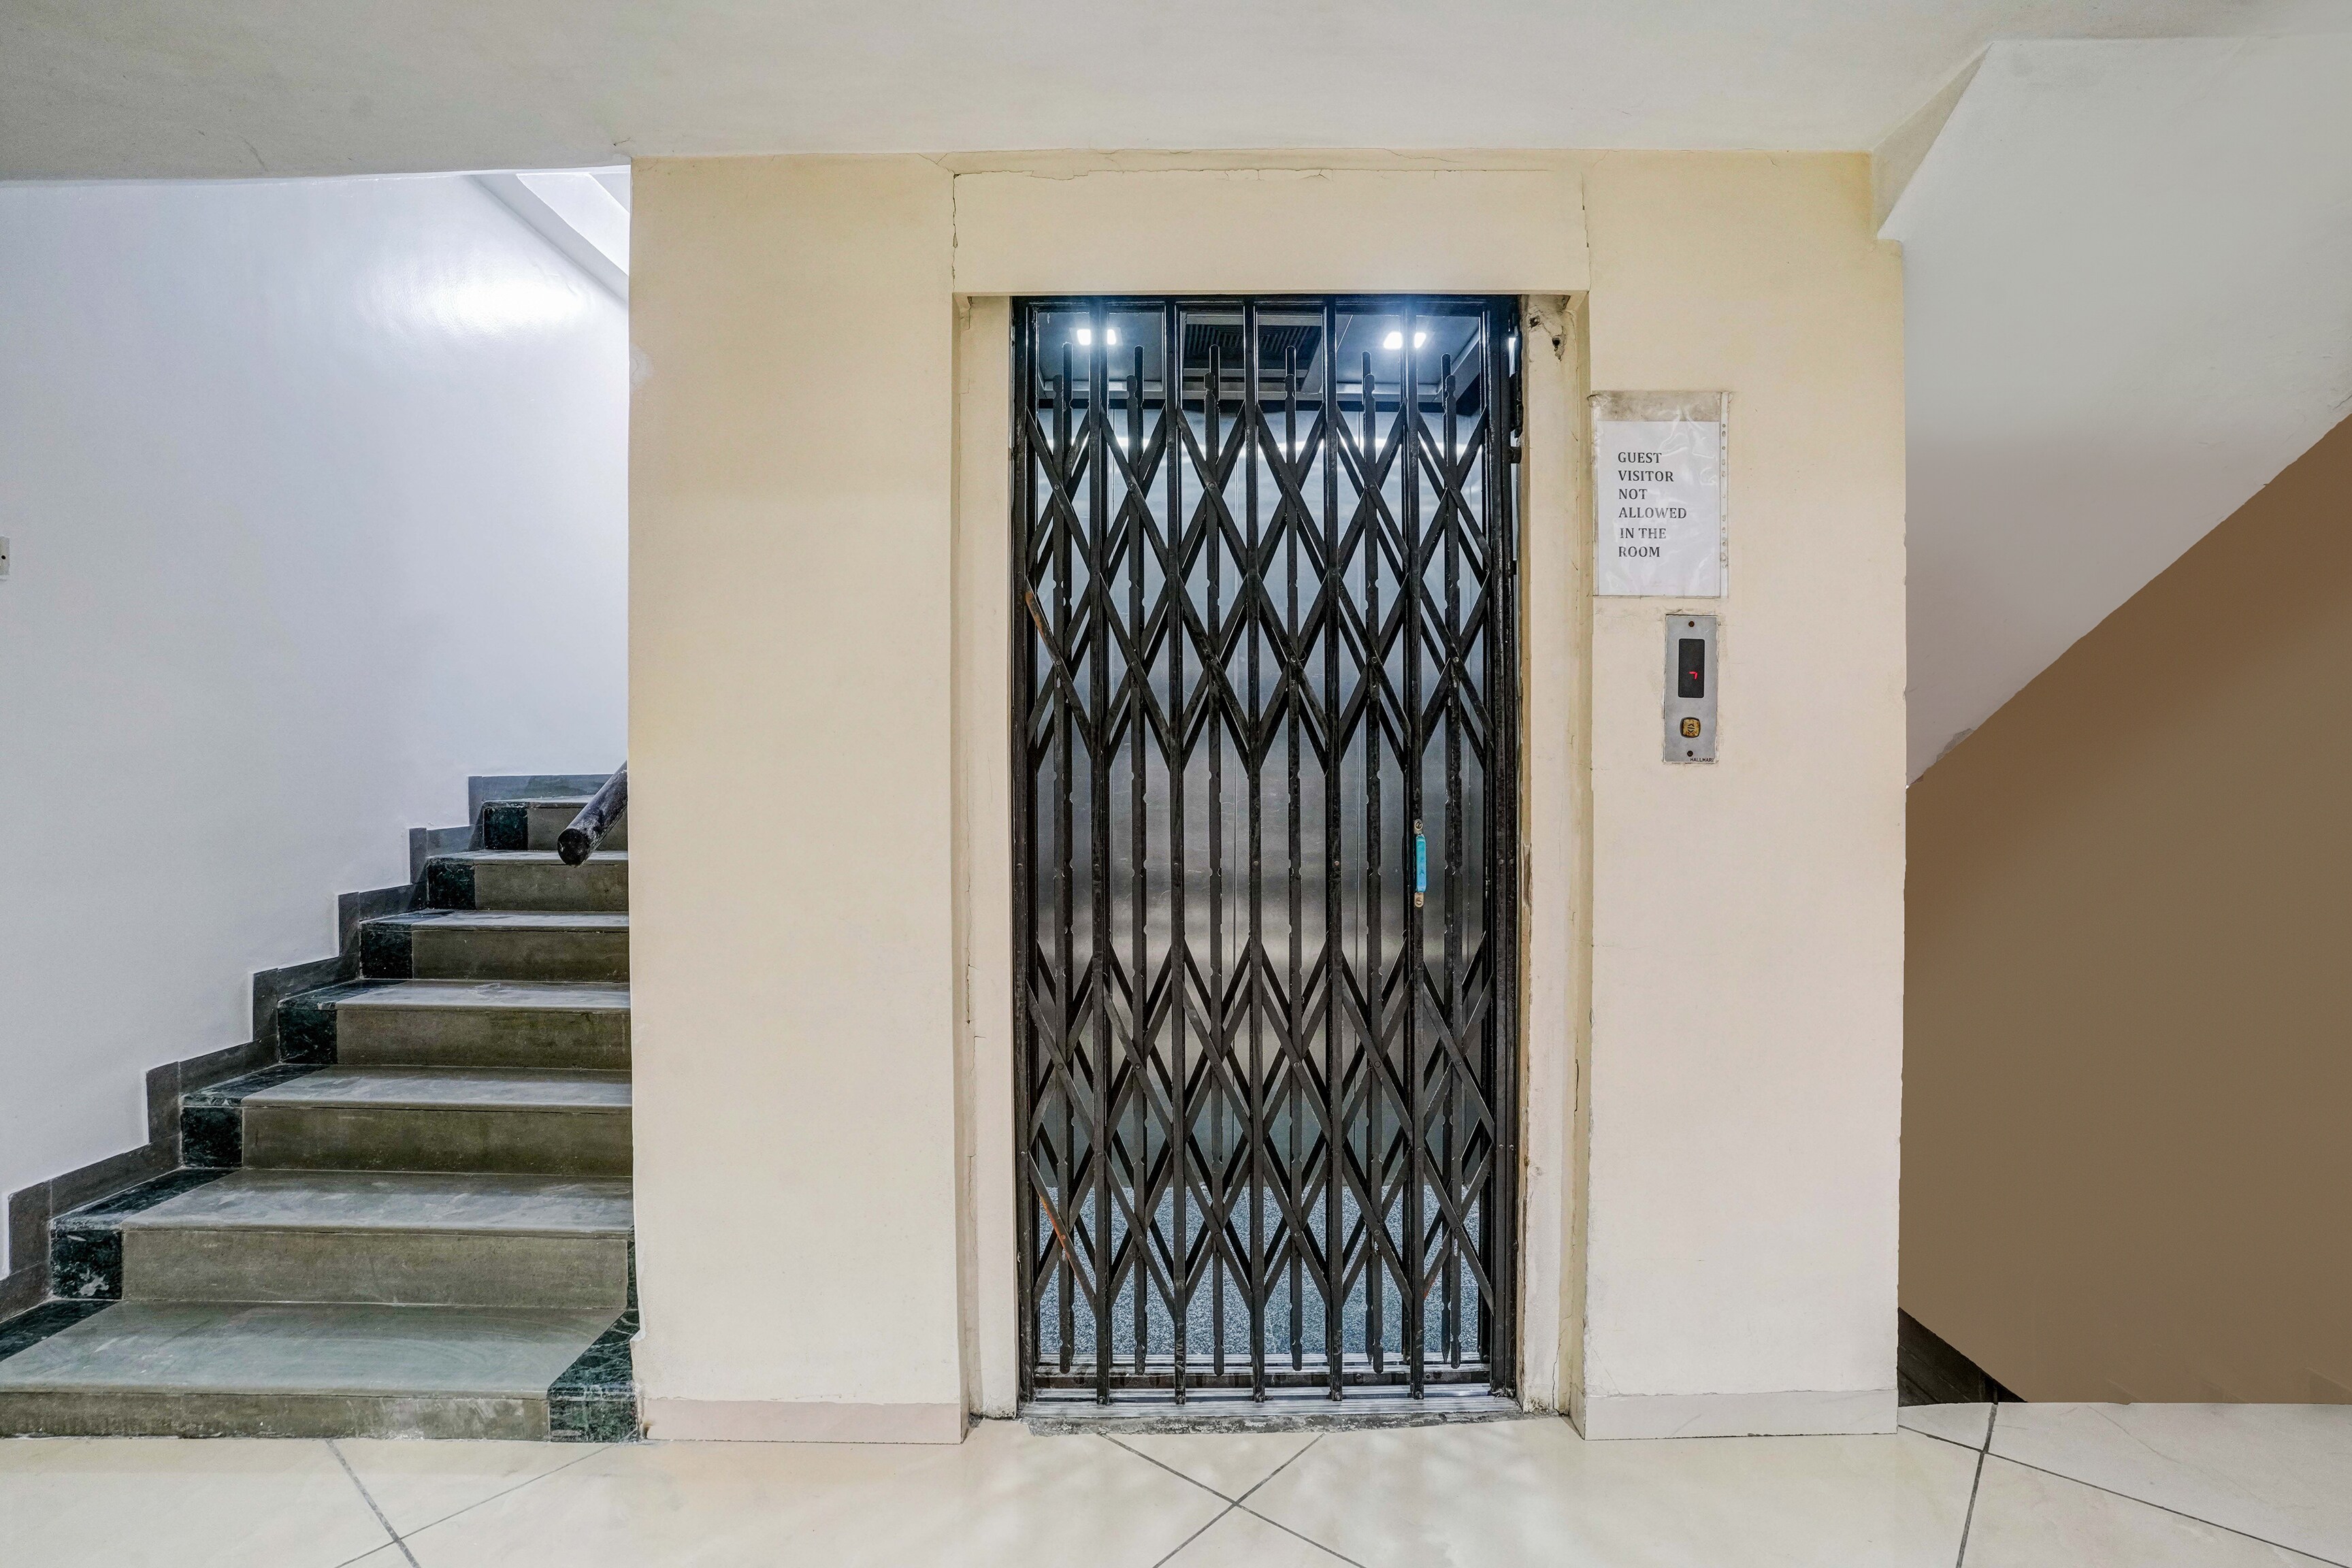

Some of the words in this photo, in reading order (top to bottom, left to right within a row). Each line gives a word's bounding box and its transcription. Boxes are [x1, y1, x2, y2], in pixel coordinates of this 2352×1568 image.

[1618, 452, 1662, 463] GUEST
[1618, 470, 1674, 482] VISITOR
[1618, 489, 1648, 500] NOT
[1618, 507, 1687, 519] ALLOWED
[1620, 527, 1634, 539] IN
[1638, 528, 1666, 539] THE
[1618, 546, 1660, 557] ROOM
